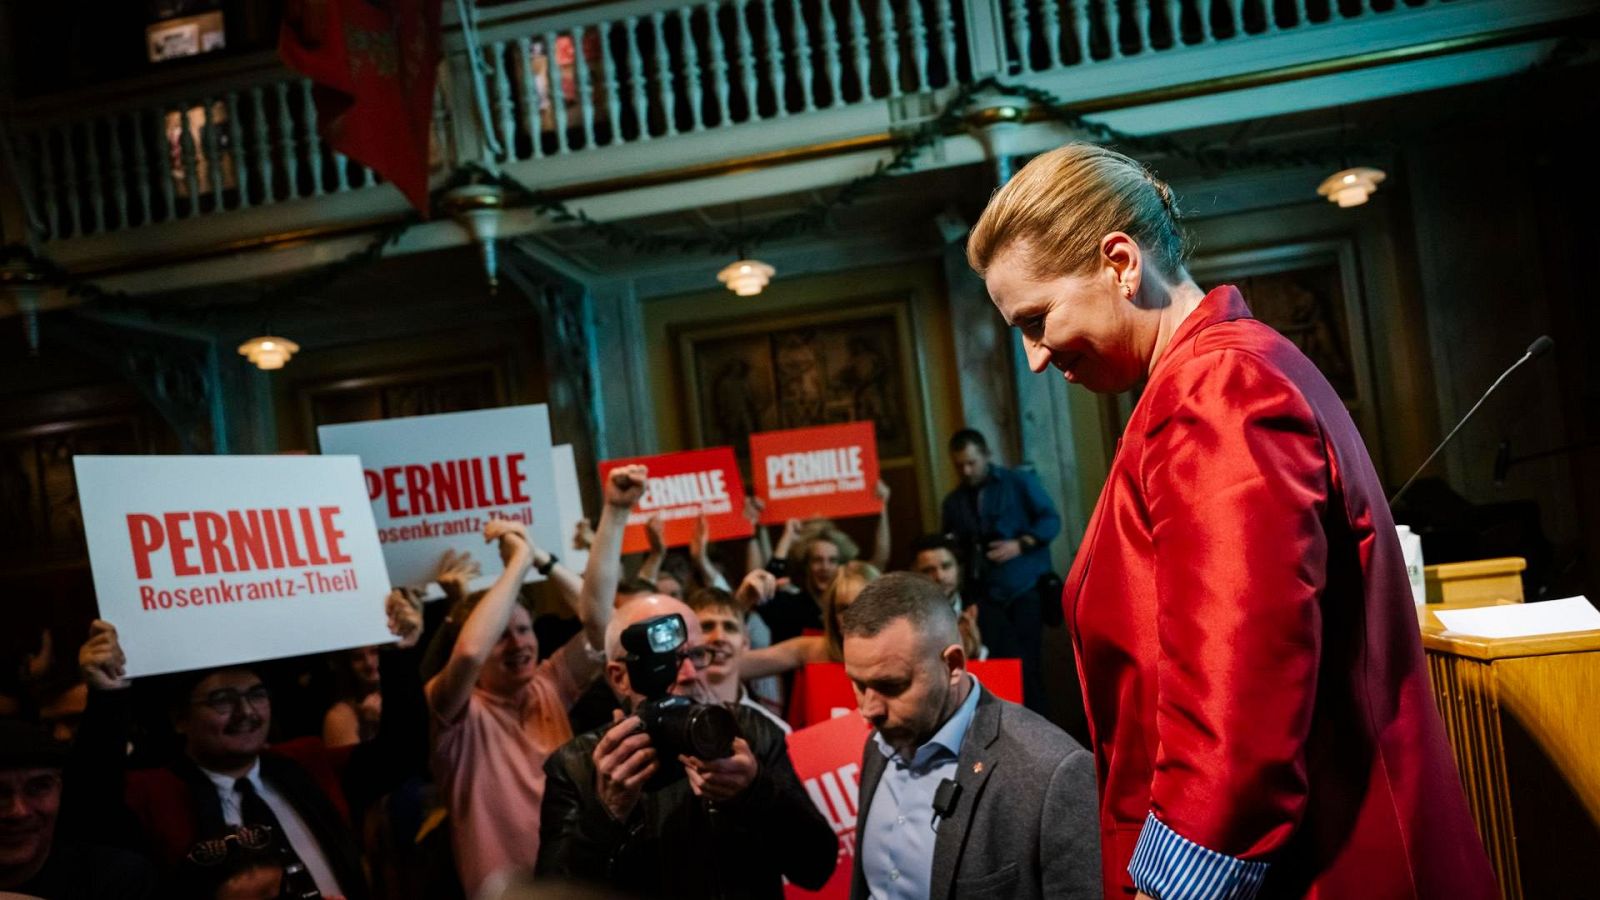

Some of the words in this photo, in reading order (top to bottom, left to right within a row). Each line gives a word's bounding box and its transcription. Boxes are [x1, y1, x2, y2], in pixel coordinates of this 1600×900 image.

[362, 453, 531, 519] PERNILLE
[765, 446, 865, 487] PERNILLE
[639, 469, 730, 511] ERNILLE
[126, 505, 352, 581] PERNILLE
[377, 507, 533, 546] osenkrantz-Theil
[138, 569, 359, 611] Rosenkrantz-Theil
